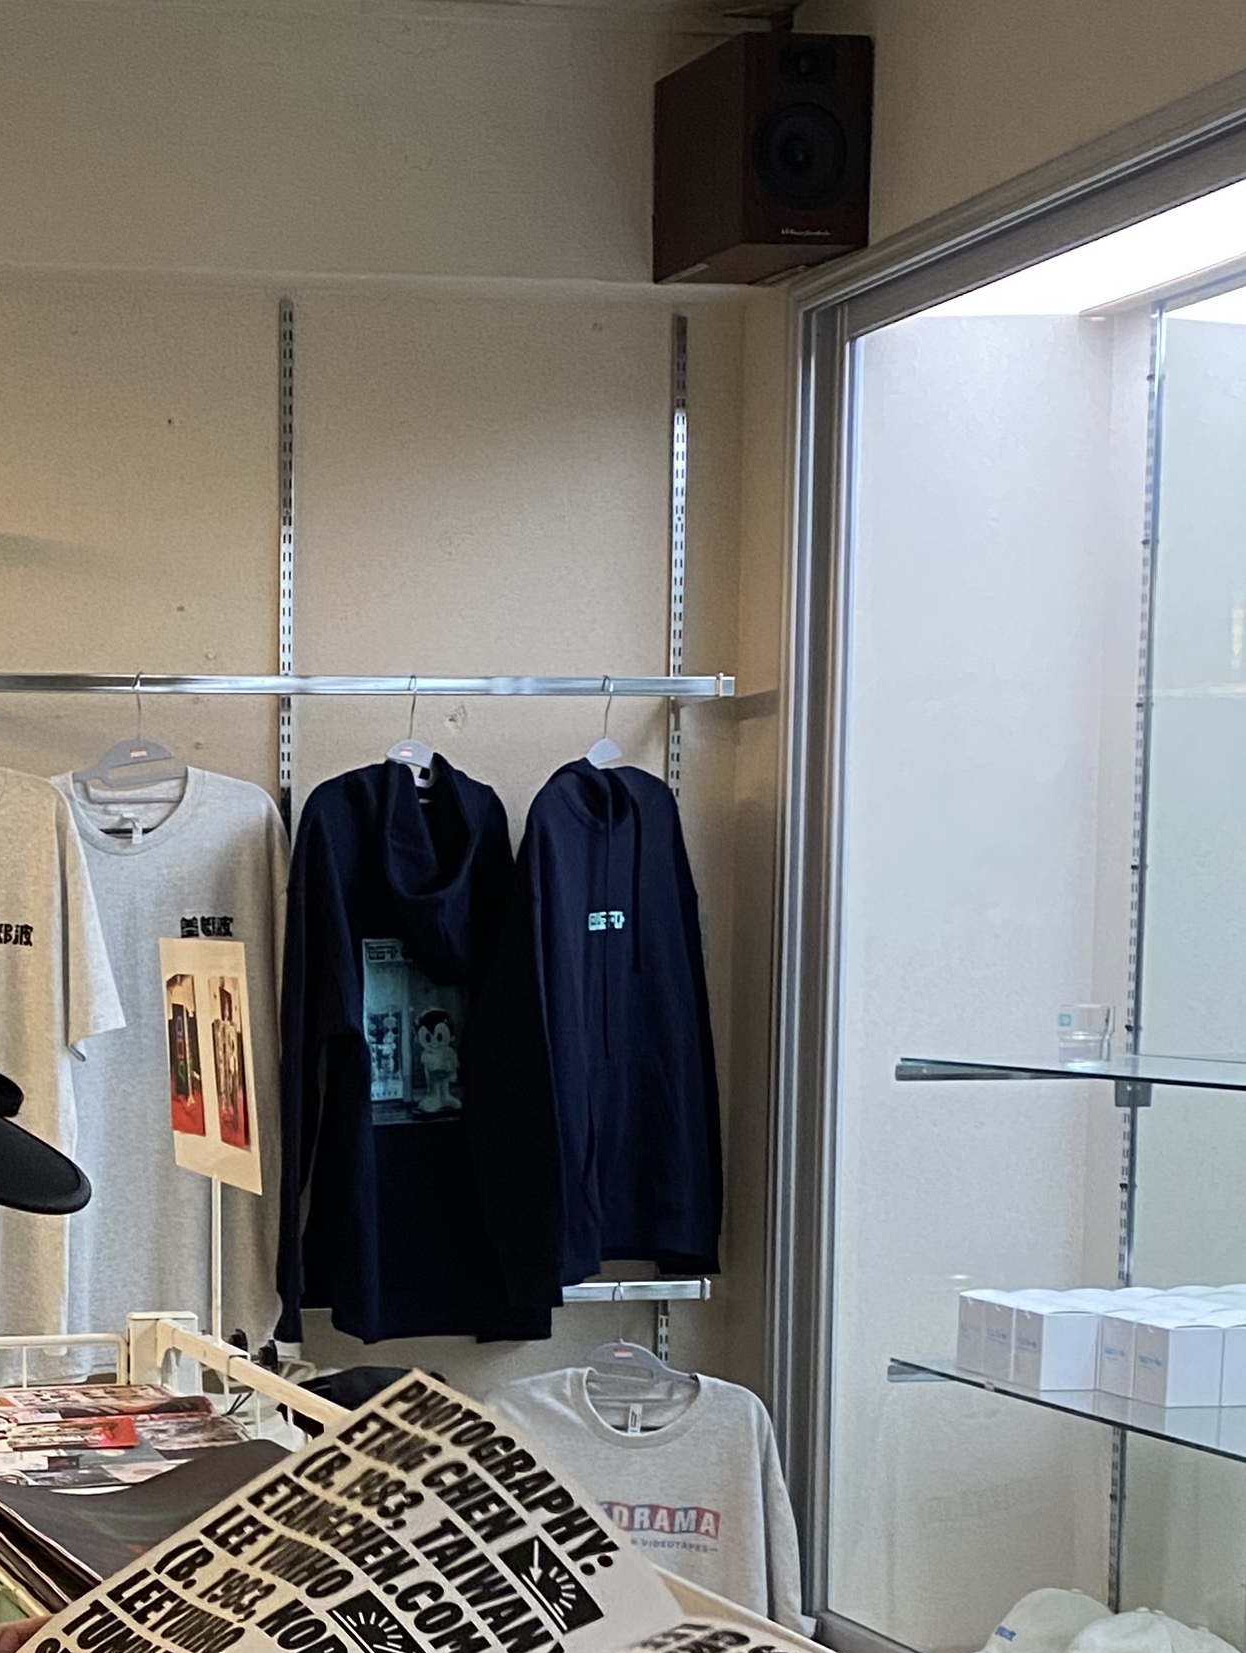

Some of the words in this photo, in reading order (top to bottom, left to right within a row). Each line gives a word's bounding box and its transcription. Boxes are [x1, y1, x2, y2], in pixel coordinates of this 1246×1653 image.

[294, 1445, 351, 1489] (B.
[338, 1468, 425, 1530] 1983,
[337, 1412, 443, 1474] ETANG
[422, 1461, 528, 1545] CHEN
[382, 1379, 620, 1577] PHOTOGRAPHY:
[601, 1502, 718, 1537] DRAMA
[154, 1539, 214, 1589] (B.
[198, 1567, 276, 1623] 1983,
[200, 1504, 274, 1557] LEE
[247, 1534, 354, 1598] YUNHO
